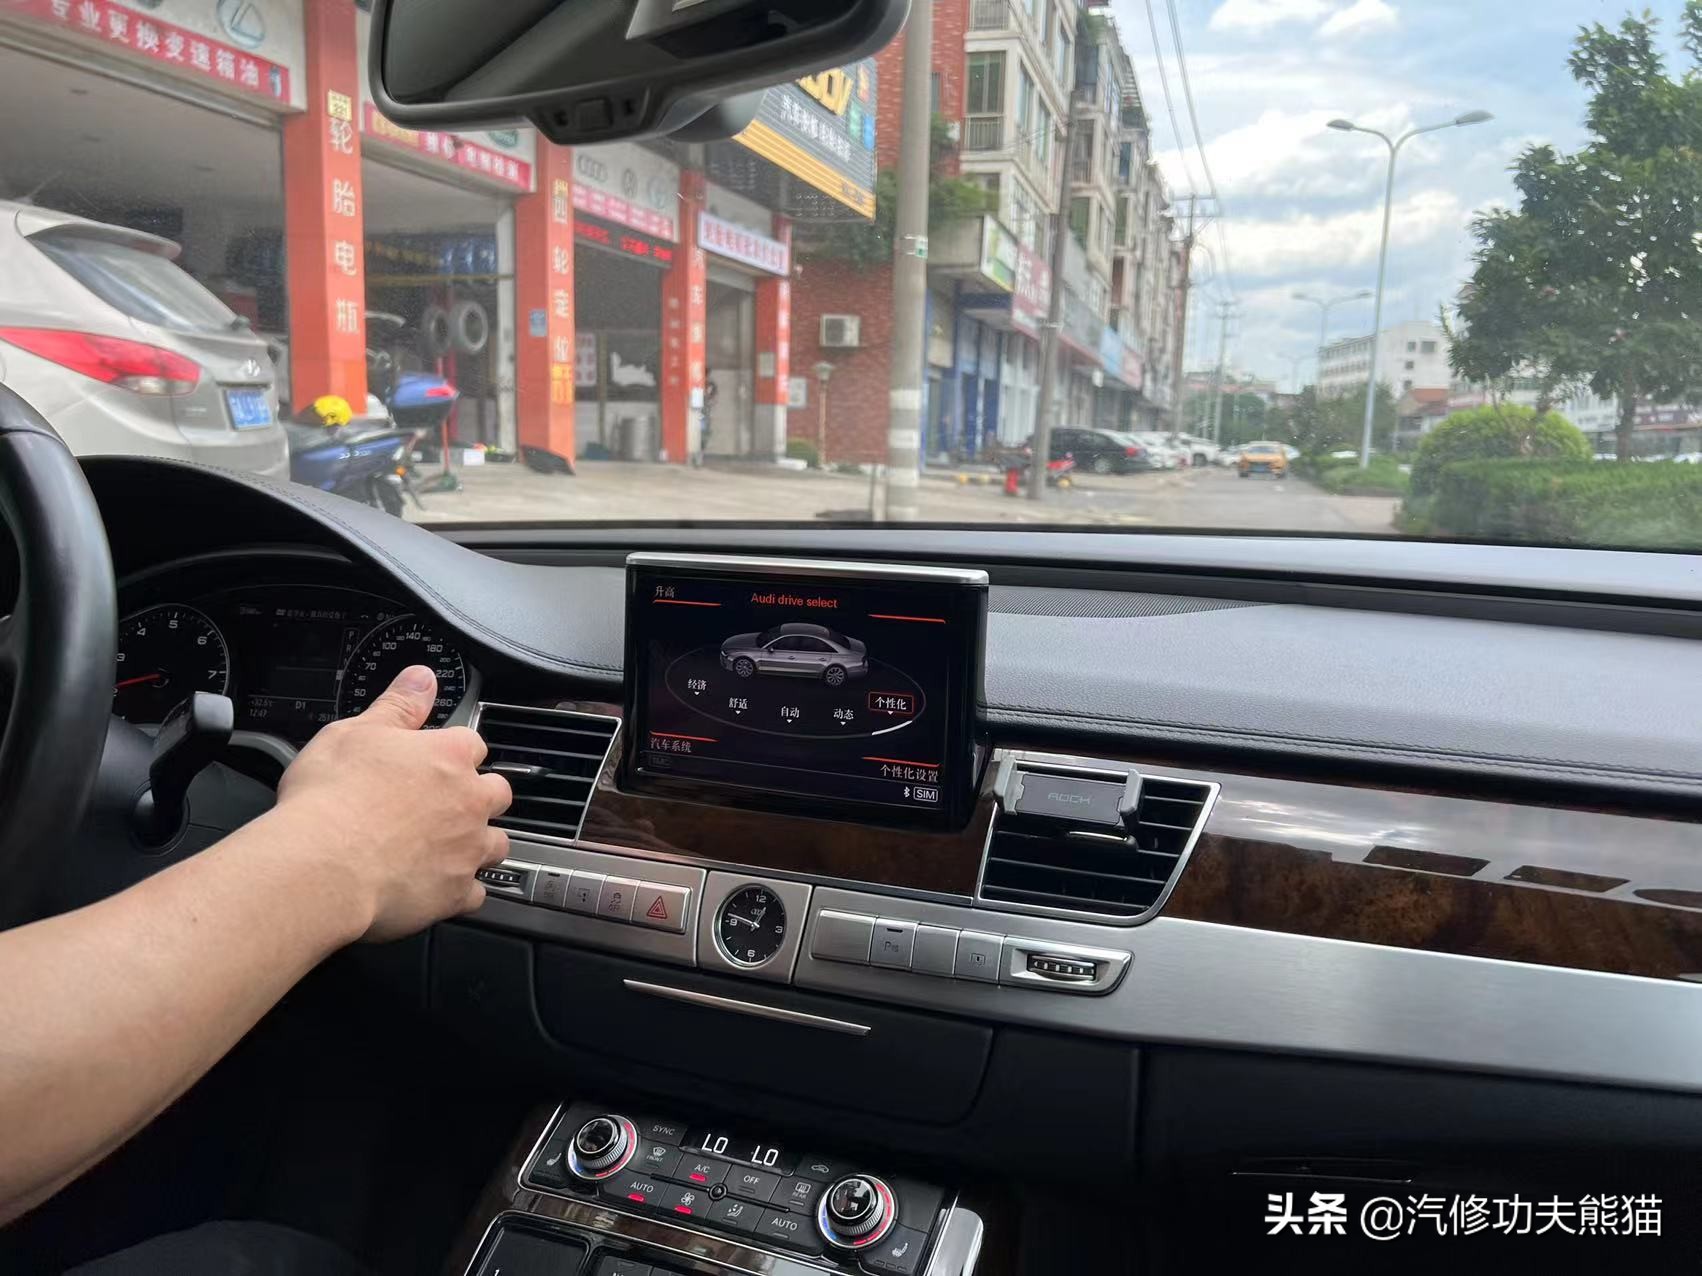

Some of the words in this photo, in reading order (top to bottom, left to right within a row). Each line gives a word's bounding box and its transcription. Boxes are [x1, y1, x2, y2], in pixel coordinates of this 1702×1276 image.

[654, 585, 675, 599] 升高
[751, 593, 775, 605] Audi
[777, 594, 804, 606] drive
[806, 596, 838, 609] select
[168, 620, 179, 629] 5
[136, 627, 147, 637] 4
[405, 632, 421, 641] 140
[197, 636, 208, 646] 6
[382, 641, 397, 650] 100
[426, 644, 443, 653] 180
[116, 652, 126, 662] 3
[365, 662, 377, 671] 70
[207, 670, 219, 680] 7
[435, 670, 455, 678] 220
[687, 678, 707, 691] 经济
[353, 688, 366, 697] 50
[728, 697, 748, 710] 舒适
[874, 697, 906, 710] 个性化
[781, 706, 800, 719] 自动
[833, 708, 854, 720] 动态
[650, 738, 692, 753] 汽车系统
[879, 764, 939, 783] 个性化设置
[916, 789, 936, 800] SIM
[755, 894, 767, 903] 12
[729, 918, 738, 927] 9
[775, 925, 783, 934] 3
[747, 949, 756, 958] 6
[652, 1125, 676, 1137] SYNC
[701, 1133, 729, 1154] LO
[751, 1145, 779, 1167] LO
[694, 1163, 711, 1173] A/C
[743, 1174, 761, 1185] OFF
[629, 1181, 654, 1193] AUTO
[771, 1217, 798, 1231] AUTO
